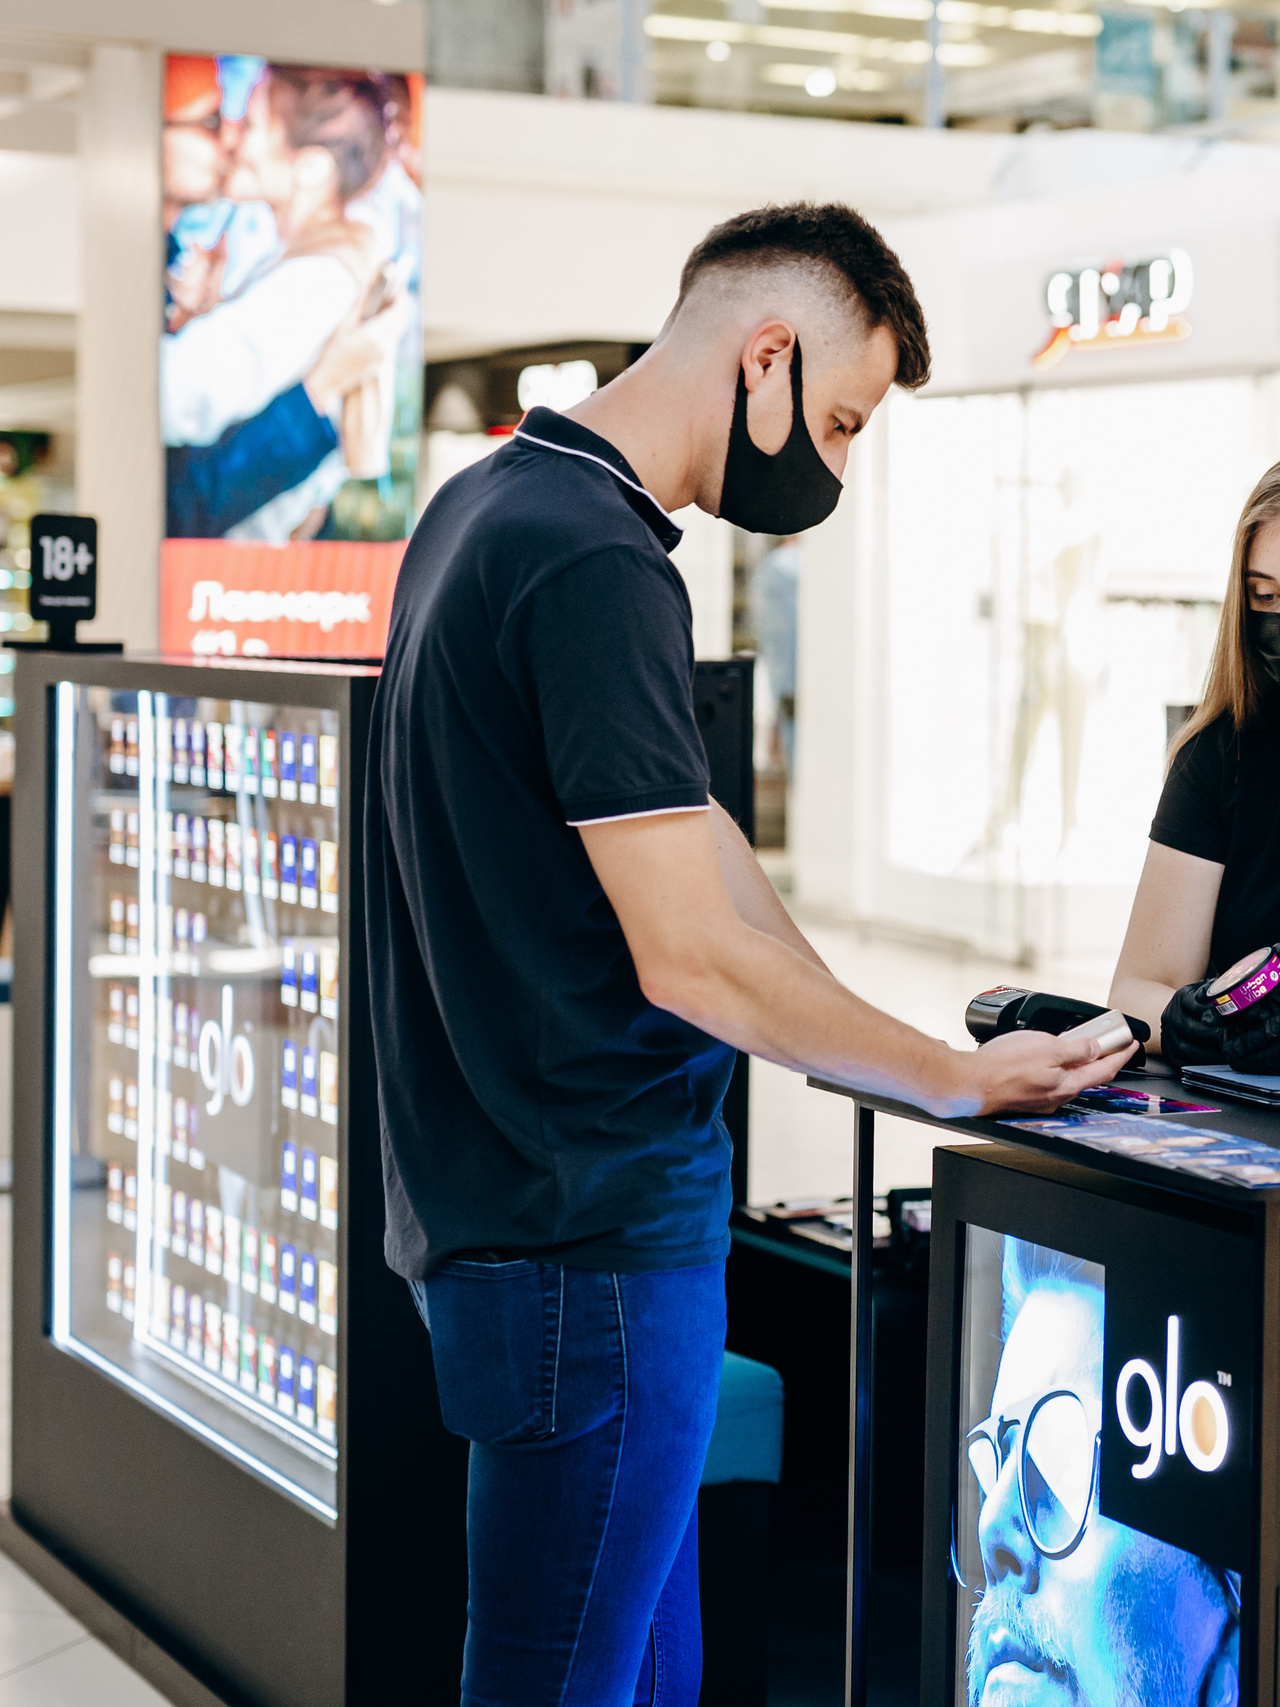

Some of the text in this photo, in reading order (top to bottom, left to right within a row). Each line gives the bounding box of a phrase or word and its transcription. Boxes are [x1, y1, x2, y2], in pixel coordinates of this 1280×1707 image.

[39, 535, 94, 582] 18+
[1245, 985, 1267, 1002] Vibe
[199, 984, 255, 1116] glo
[1116, 1315, 1229, 1479] glo
